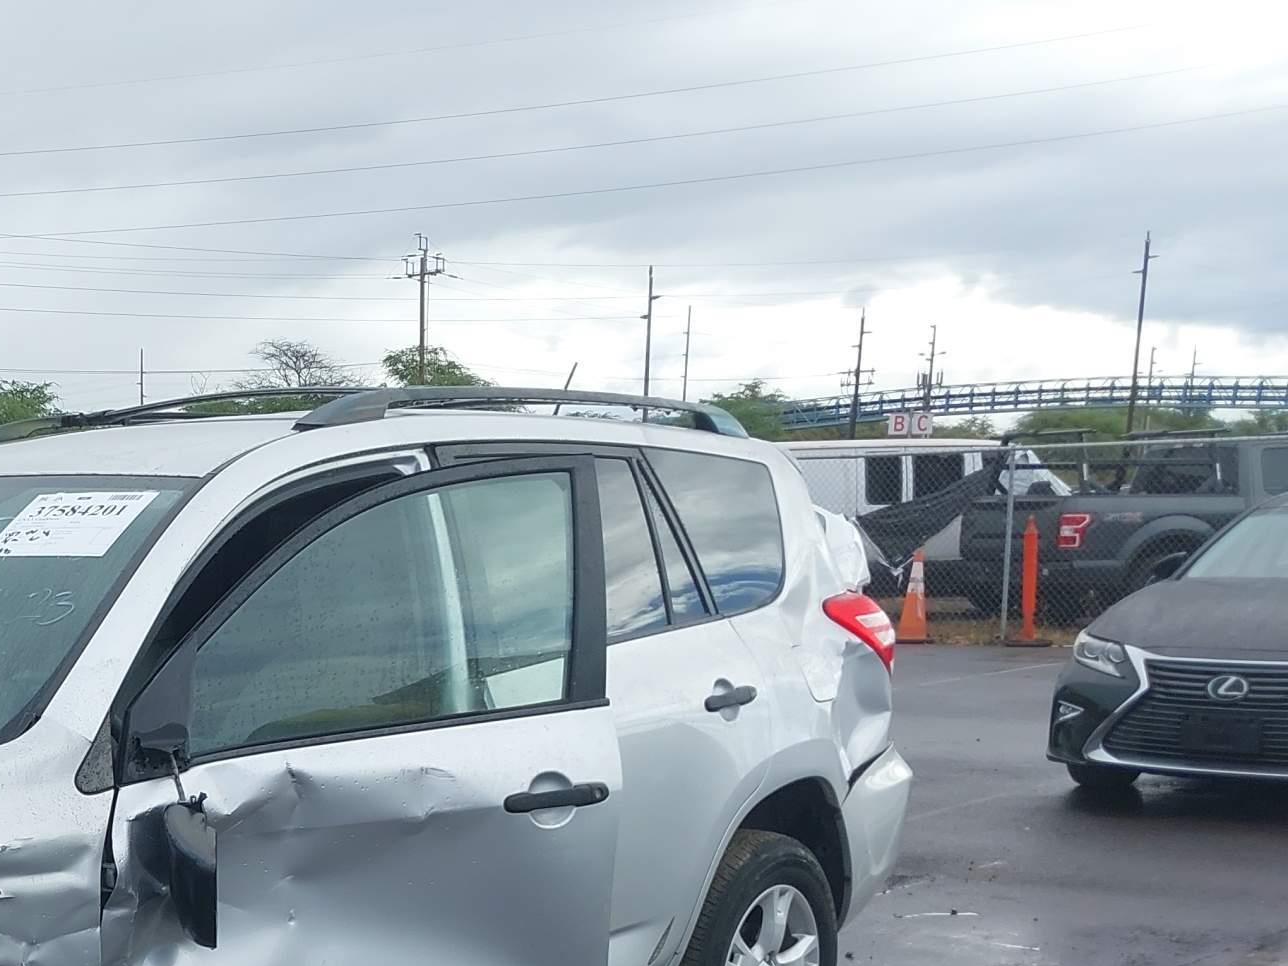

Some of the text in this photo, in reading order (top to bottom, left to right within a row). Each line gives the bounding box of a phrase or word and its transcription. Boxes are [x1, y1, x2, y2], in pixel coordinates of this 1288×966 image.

[894, 415, 905, 432] B
[917, 415, 928, 432] C
[28, 504, 129, 518] 37584201
